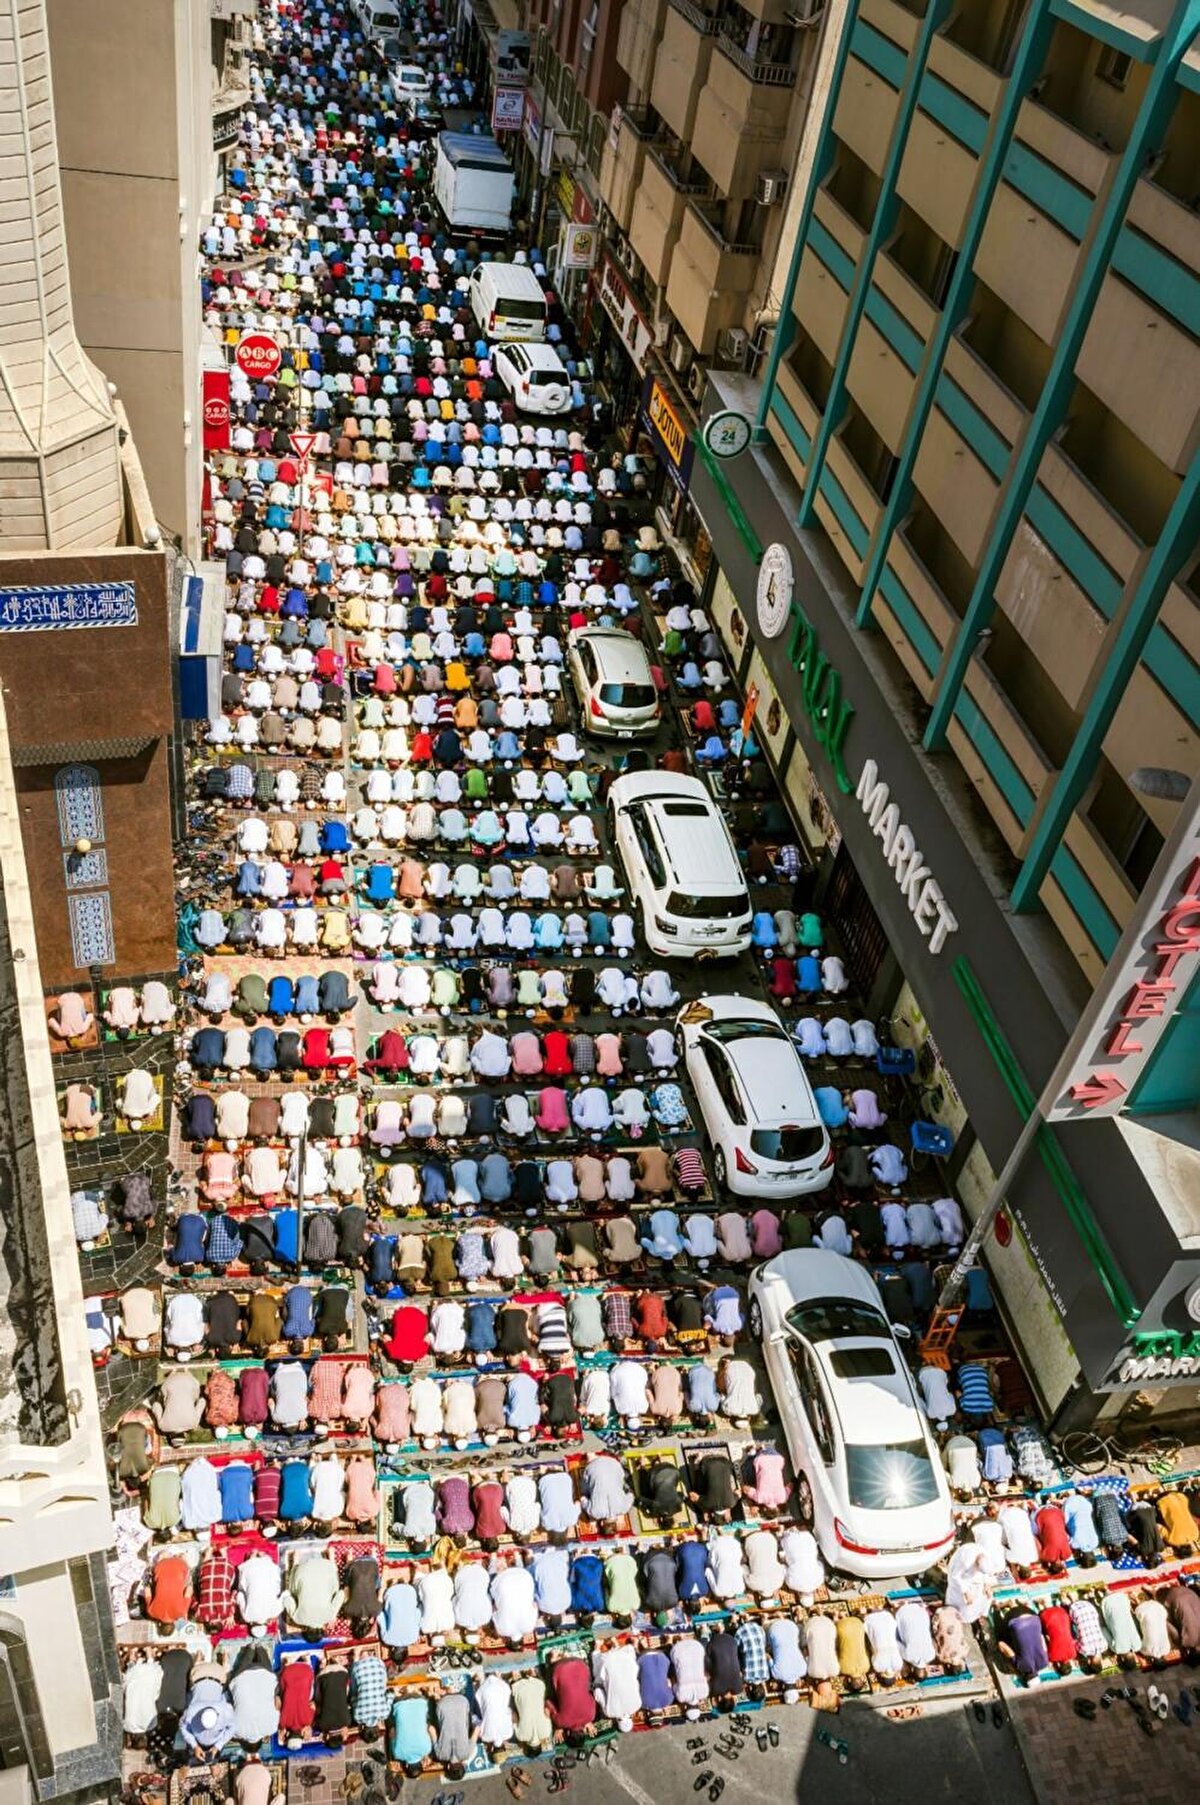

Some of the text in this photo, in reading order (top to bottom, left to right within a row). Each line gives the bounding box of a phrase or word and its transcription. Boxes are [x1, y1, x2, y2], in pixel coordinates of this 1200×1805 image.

[240, 346, 278, 360] ABC
[244, 361, 271, 369] CARGO
[658, 405, 682, 457] JOTUN
[720, 430, 736, 441] 24
[856, 759, 959, 954] MARKET
